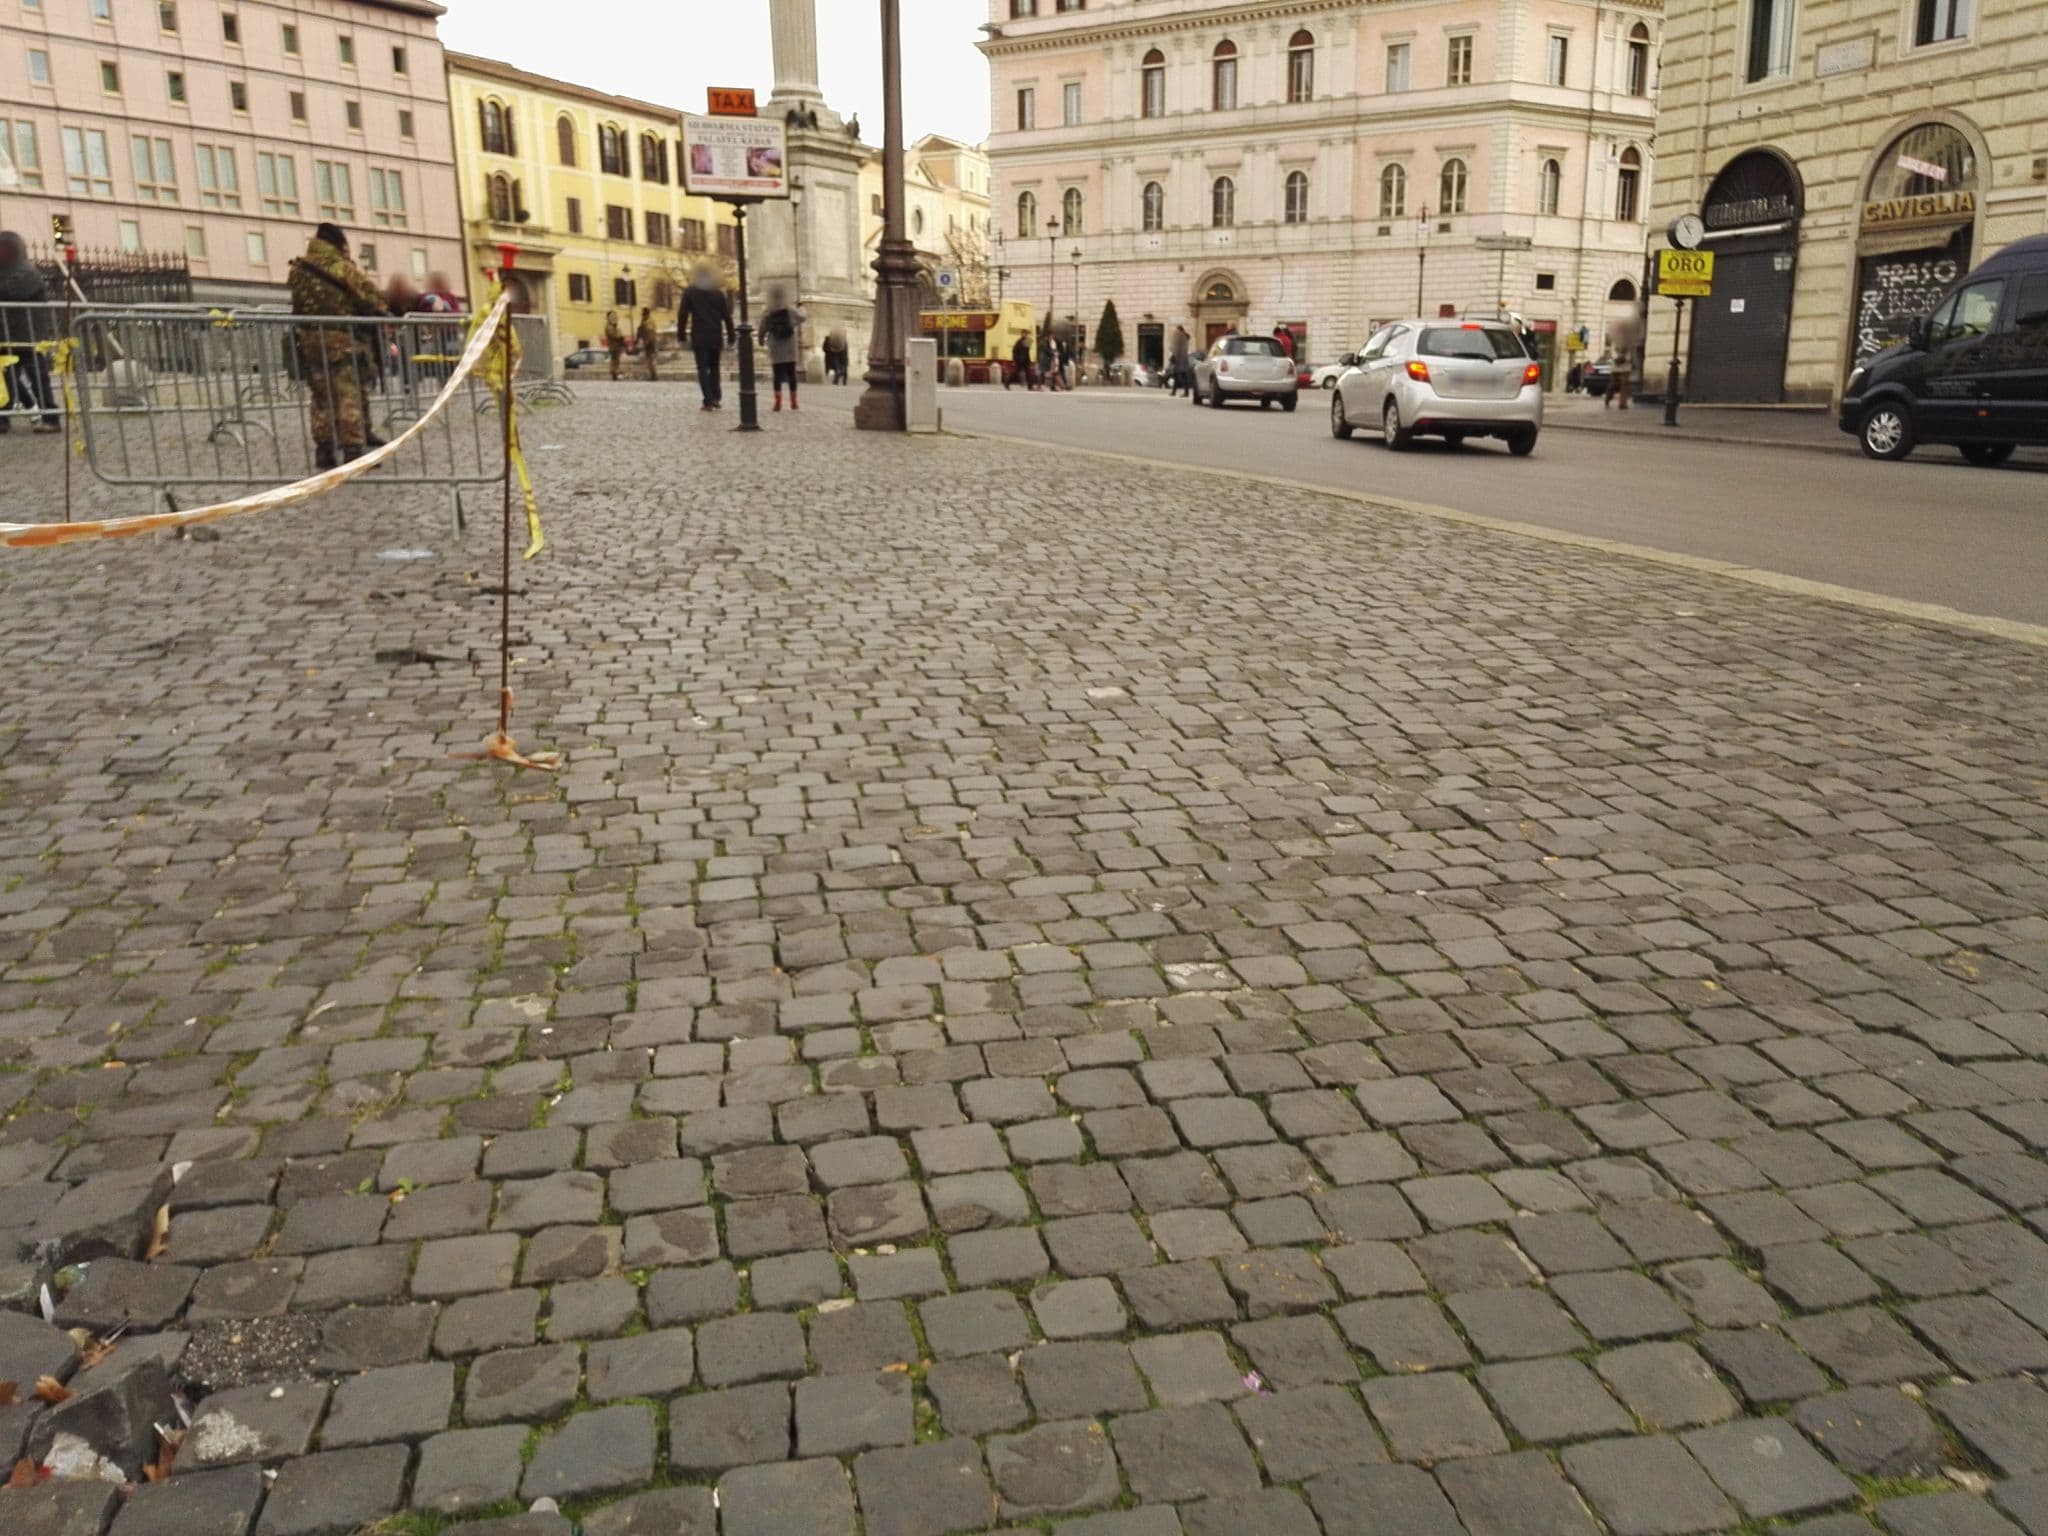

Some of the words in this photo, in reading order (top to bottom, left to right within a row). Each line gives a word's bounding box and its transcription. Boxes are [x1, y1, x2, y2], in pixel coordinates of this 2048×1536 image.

[711, 92, 755, 110] TAXI
[1668, 256, 1705, 272] ORO
[935, 315, 968, 329] ROME
